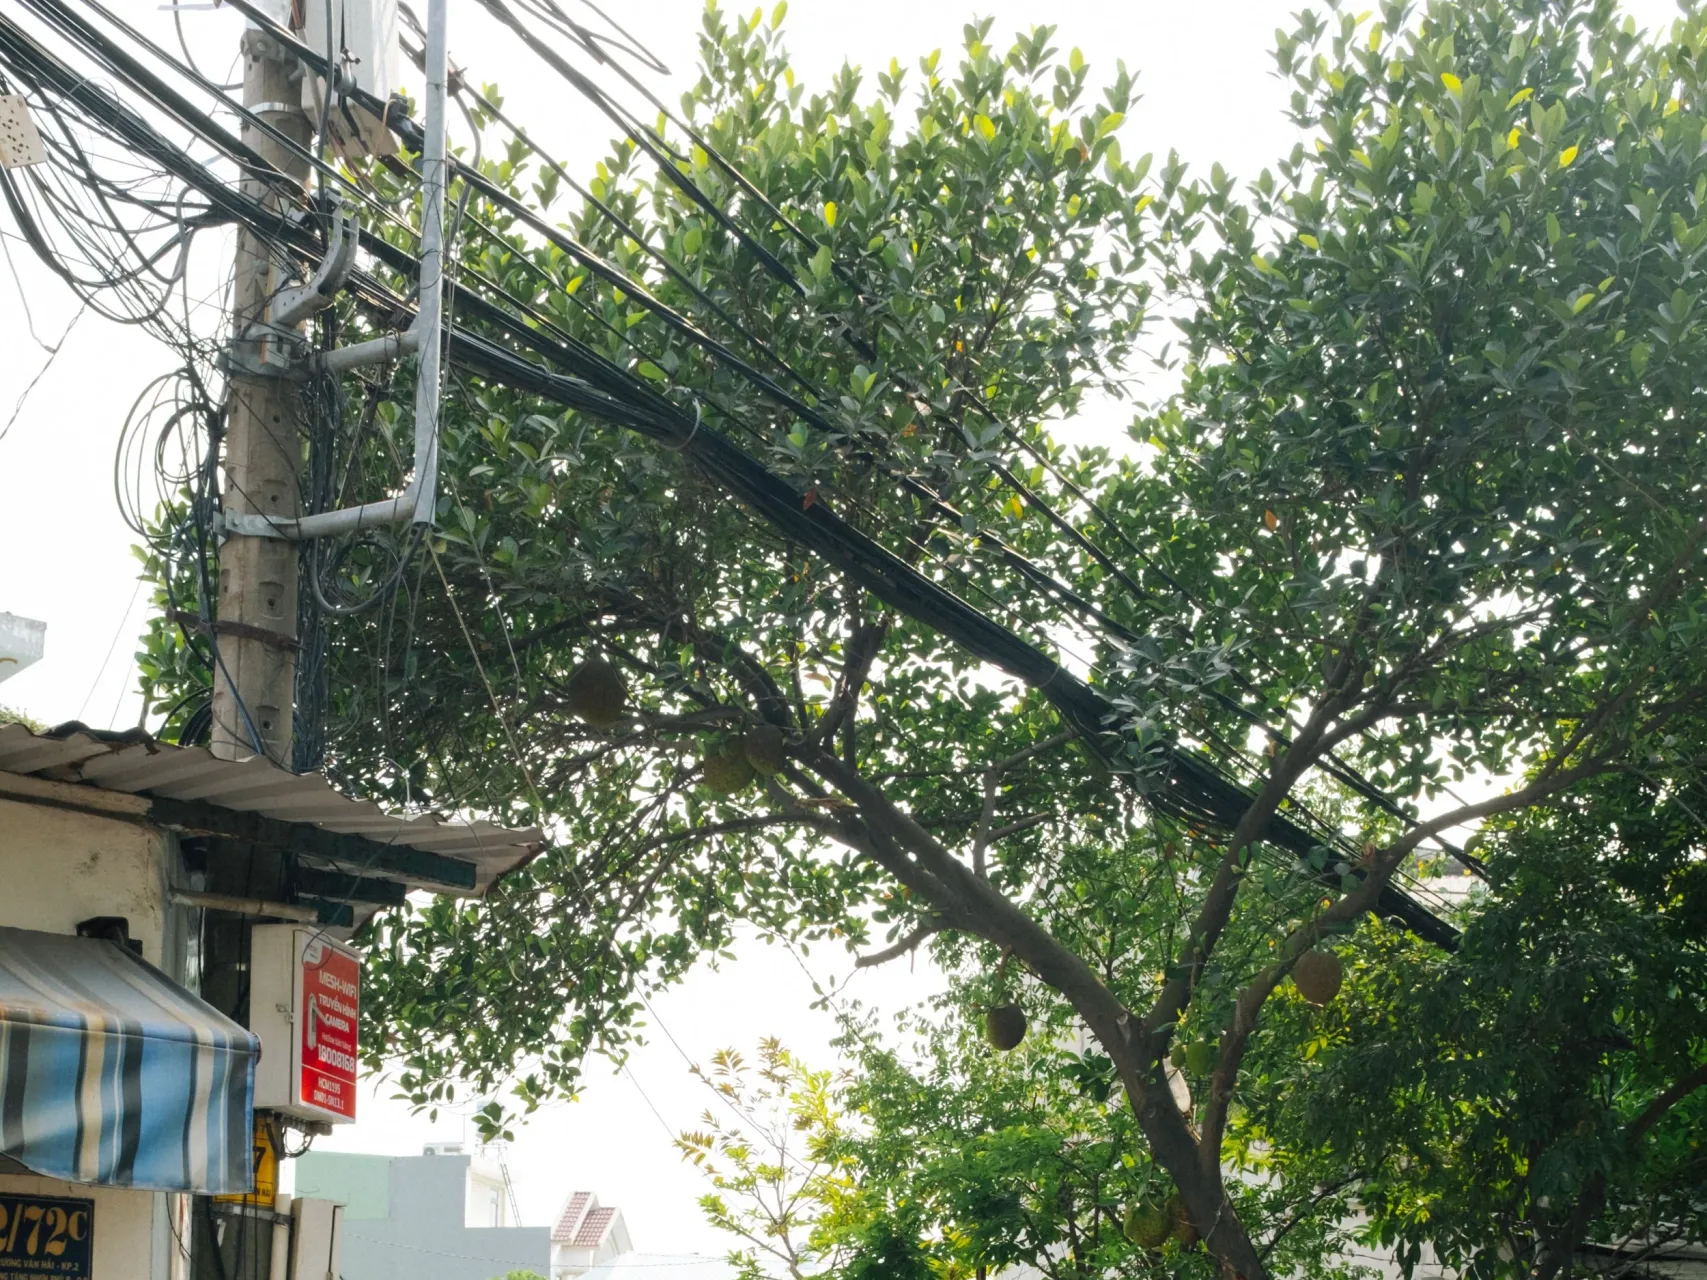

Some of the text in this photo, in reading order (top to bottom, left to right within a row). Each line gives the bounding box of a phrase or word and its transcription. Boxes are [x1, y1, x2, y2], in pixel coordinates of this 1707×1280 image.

[319, 970, 357, 1000] MESH-WIFI
[324, 1013, 350, 1033] CAMERA
[317, 1044, 356, 1073] 18008168
[61, 1262, 79, 1271] KP.2
